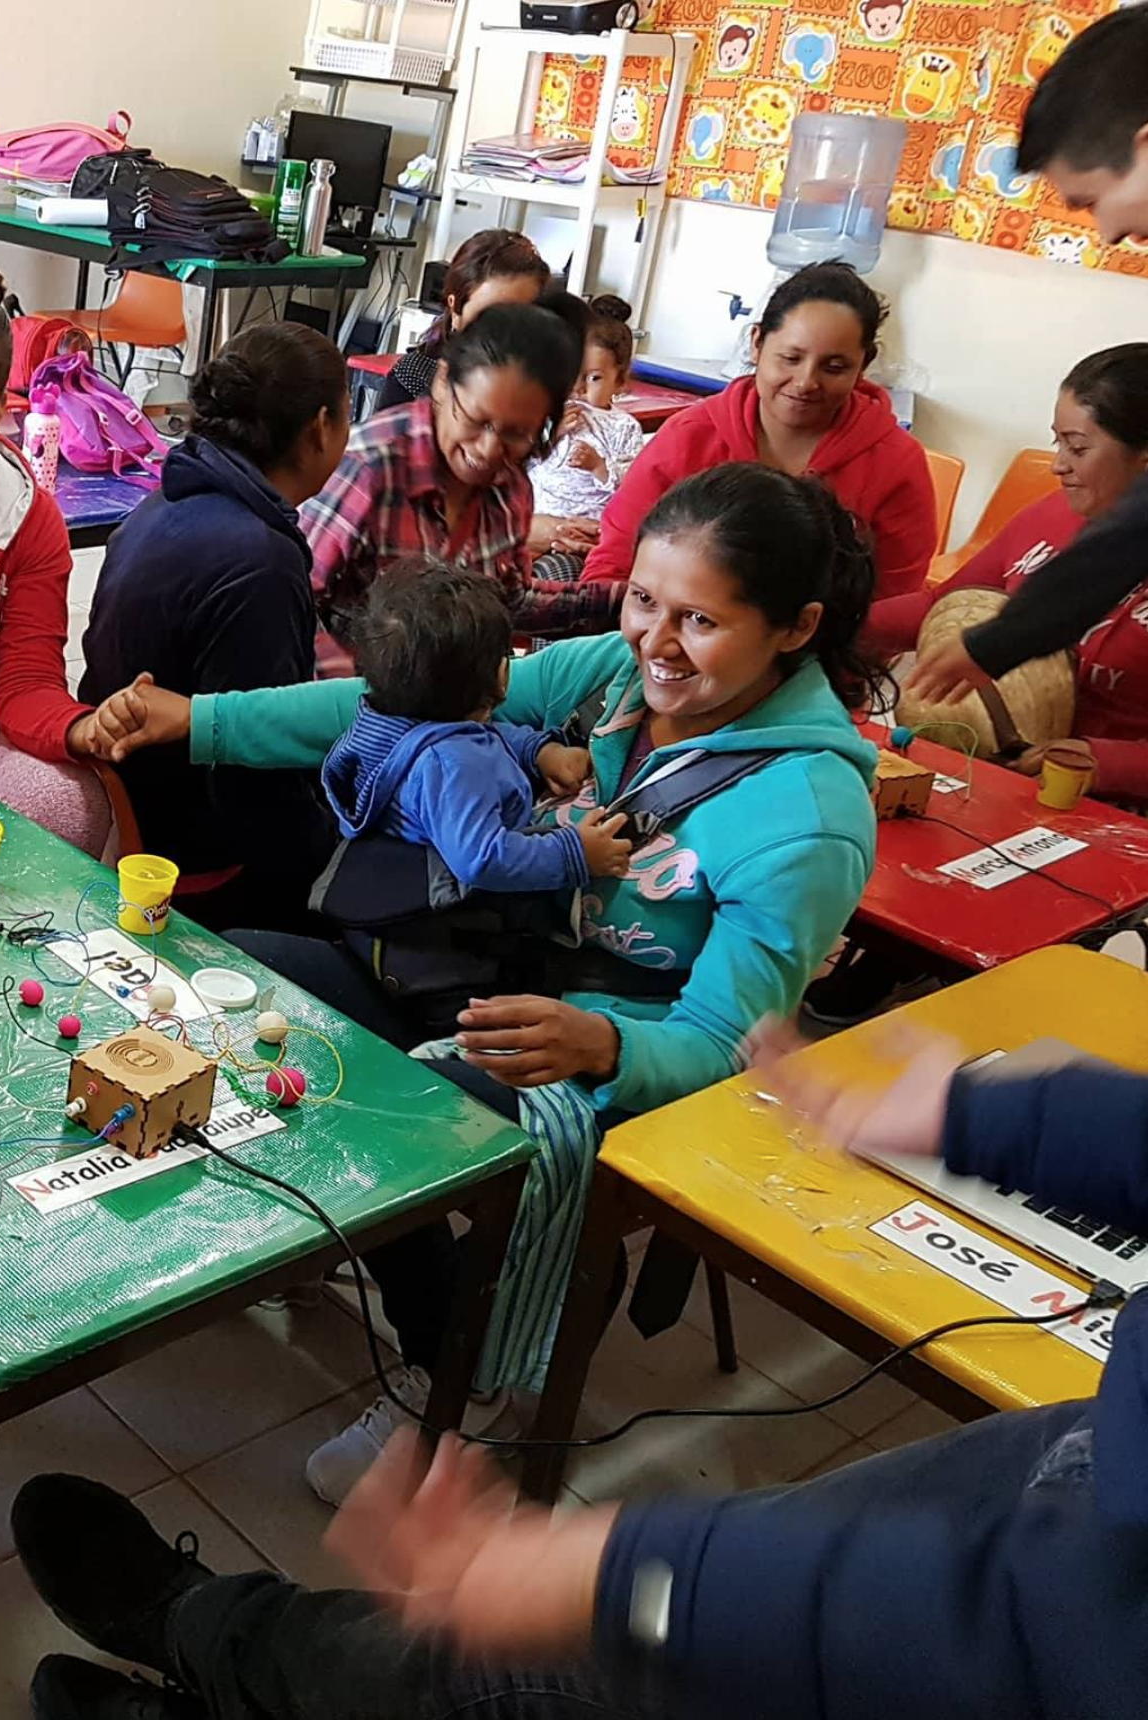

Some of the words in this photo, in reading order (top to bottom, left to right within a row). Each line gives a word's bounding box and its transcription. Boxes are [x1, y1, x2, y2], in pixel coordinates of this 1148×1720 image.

[915, 8, 978, 41] ZOO
[575, 73, 596, 124] ZOO
[837, 61, 892, 90] ZOO
[951, 856, 1012, 881] Marco
[1006, 832, 1069, 860] Antonio
[16, 1154, 132, 1202] Natalia
[891, 1210, 1019, 1283] José
